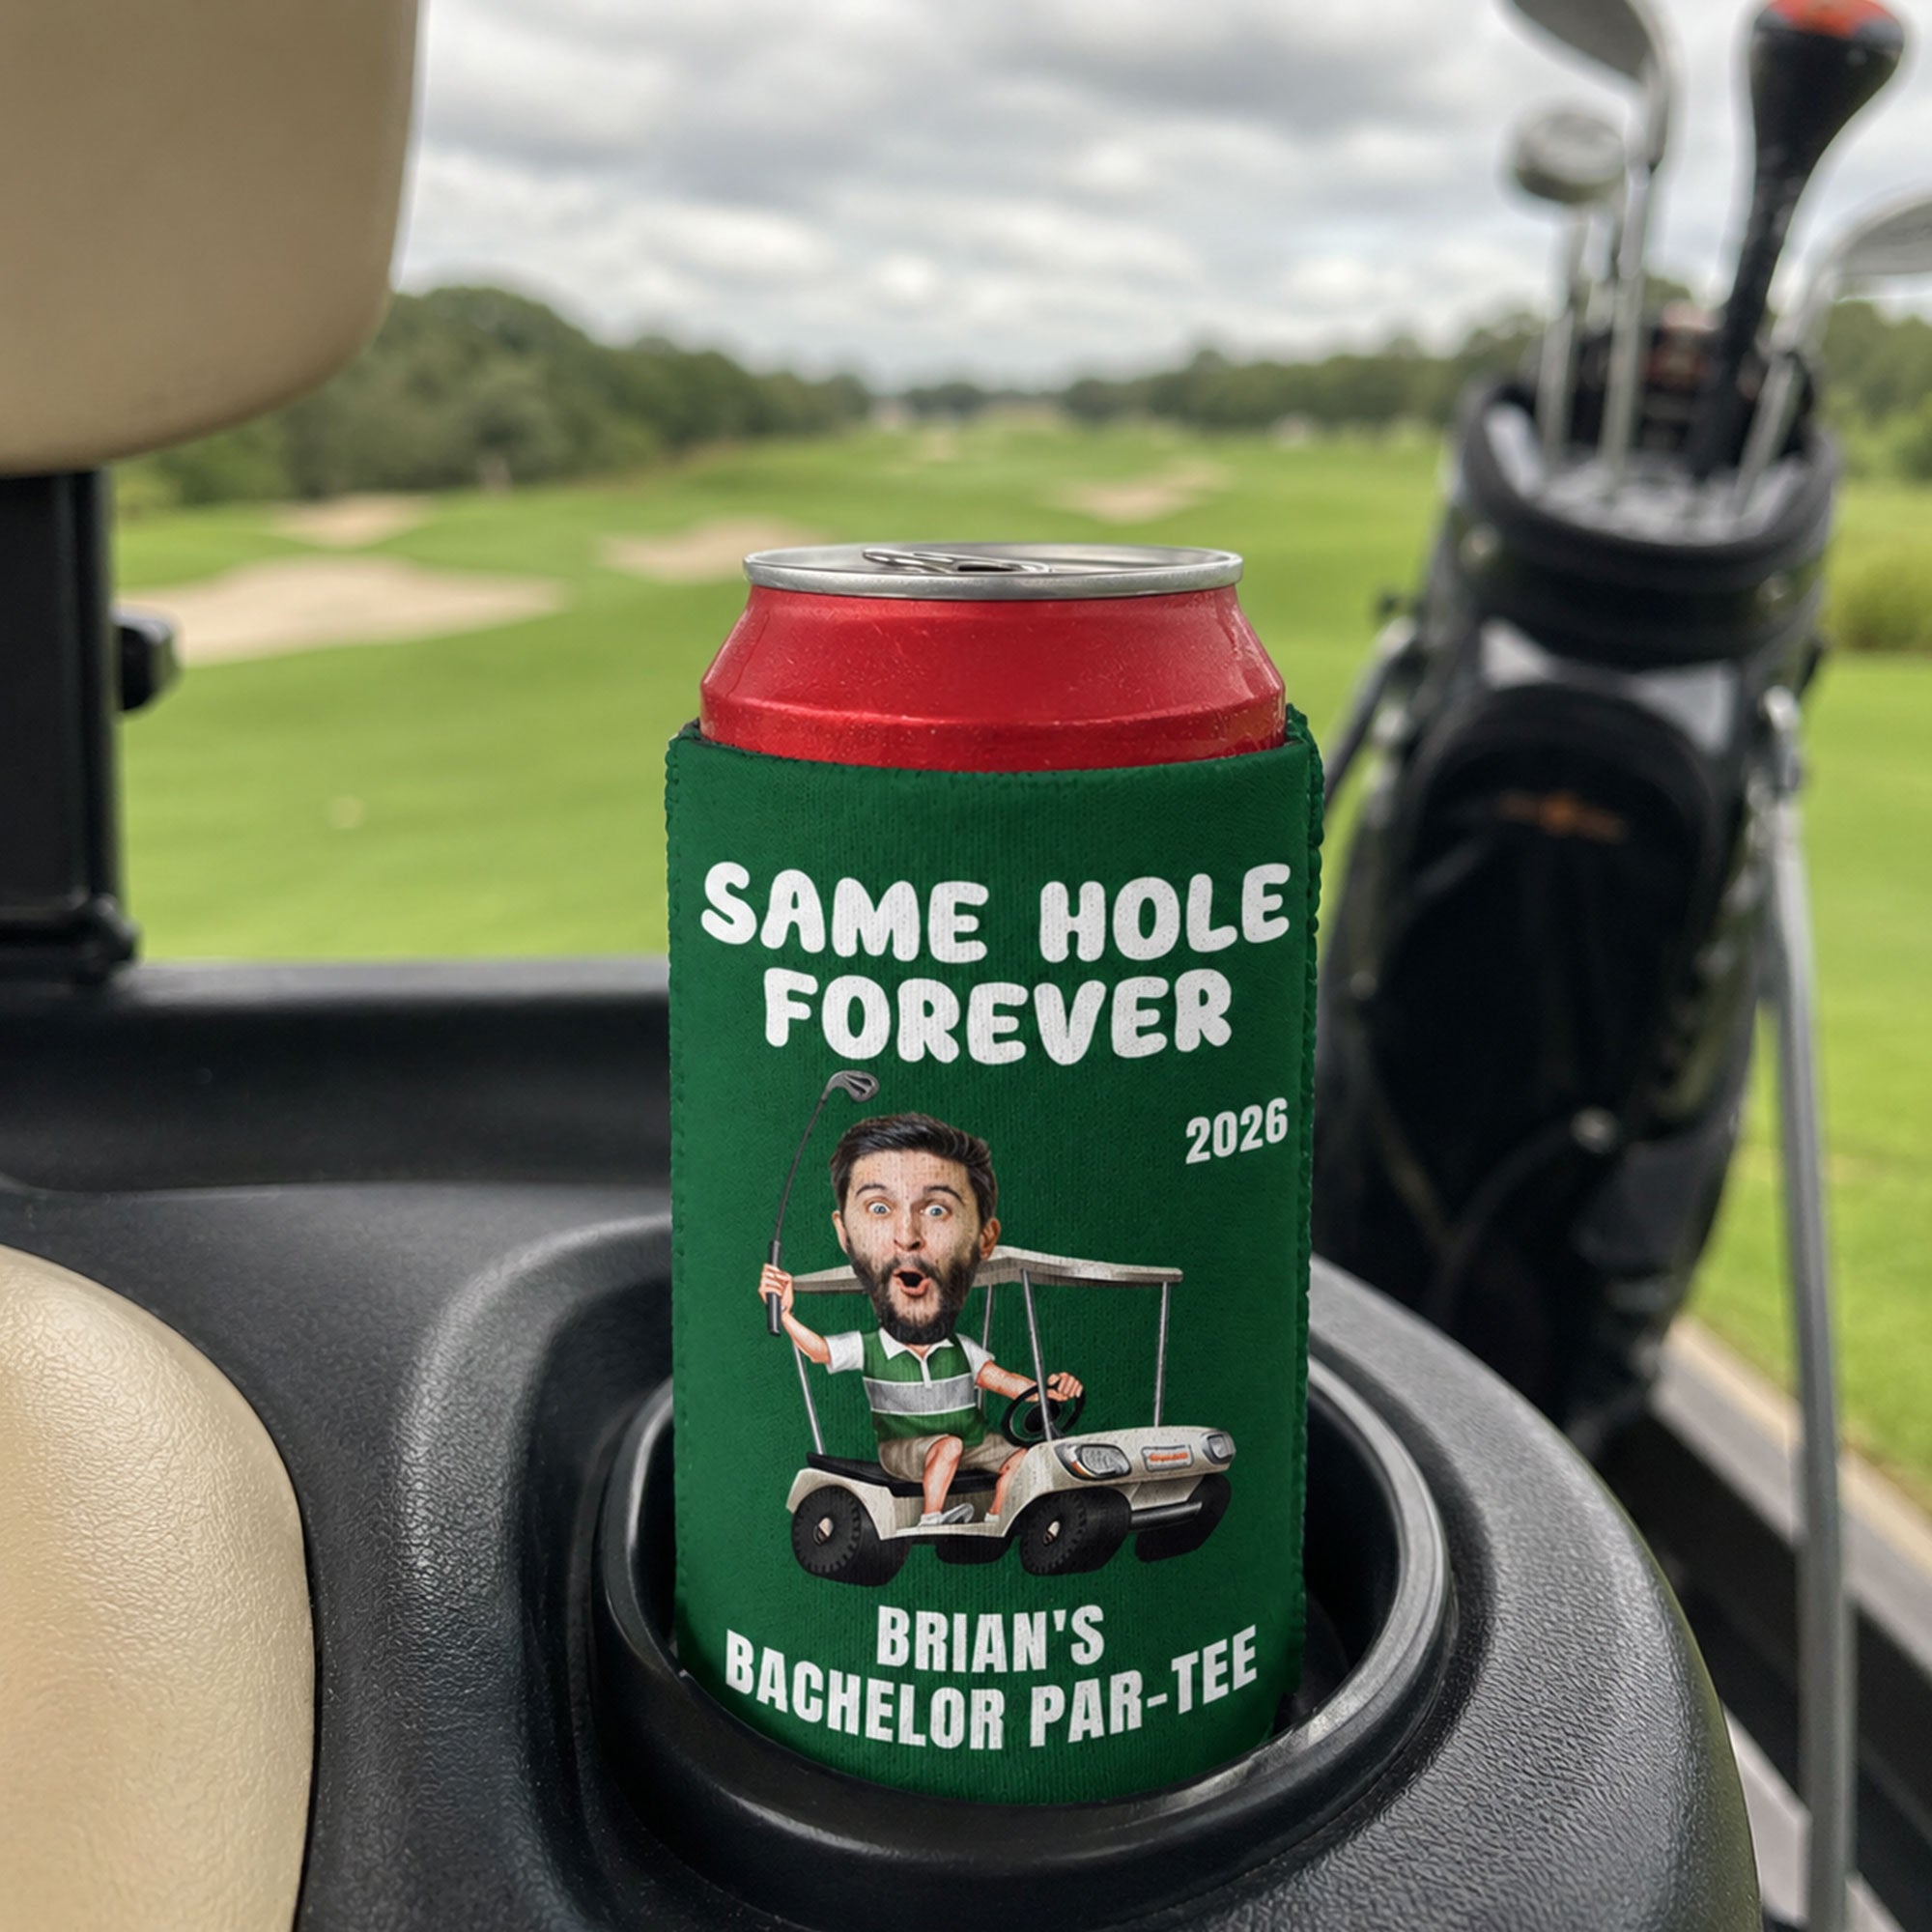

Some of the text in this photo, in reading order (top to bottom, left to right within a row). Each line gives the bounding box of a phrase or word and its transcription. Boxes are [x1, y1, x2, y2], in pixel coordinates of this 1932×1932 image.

[700, 861, 1291, 964] SAME HOLE
[763, 967, 1232, 1065] FOREVER
[1184, 1097, 1289, 1164] 2026
[725, 1625, 1257, 1750] BACHELOR PAR-TEE
[876, 1605, 1104, 1673] BRIAN'S
